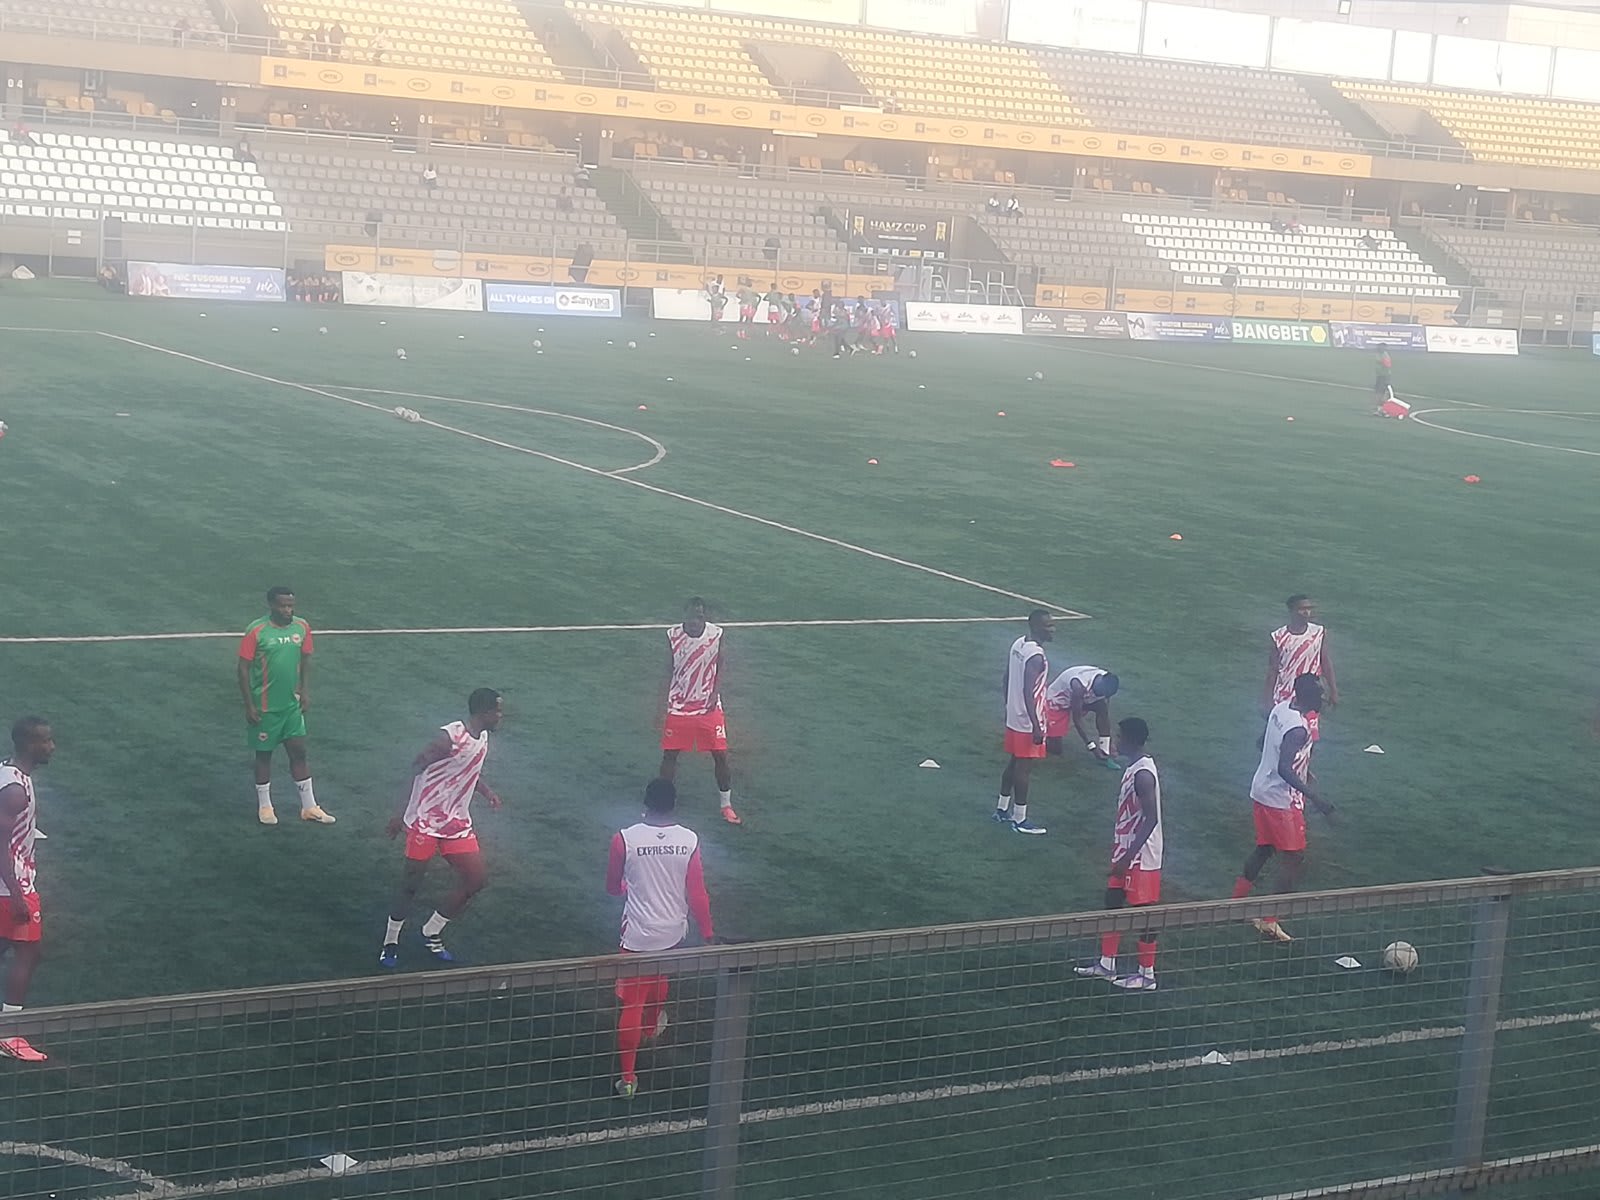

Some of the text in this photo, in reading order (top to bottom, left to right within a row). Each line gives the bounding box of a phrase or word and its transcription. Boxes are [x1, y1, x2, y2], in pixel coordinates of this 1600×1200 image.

[870, 219, 927, 233] HAMZ CUP
[230, 275, 252, 284] PLUS
[490, 293, 555, 305] ALL TV GAMES ON
[1231, 322, 1310, 342] BANGBET
[636, 845, 675, 857] EXPRESS
